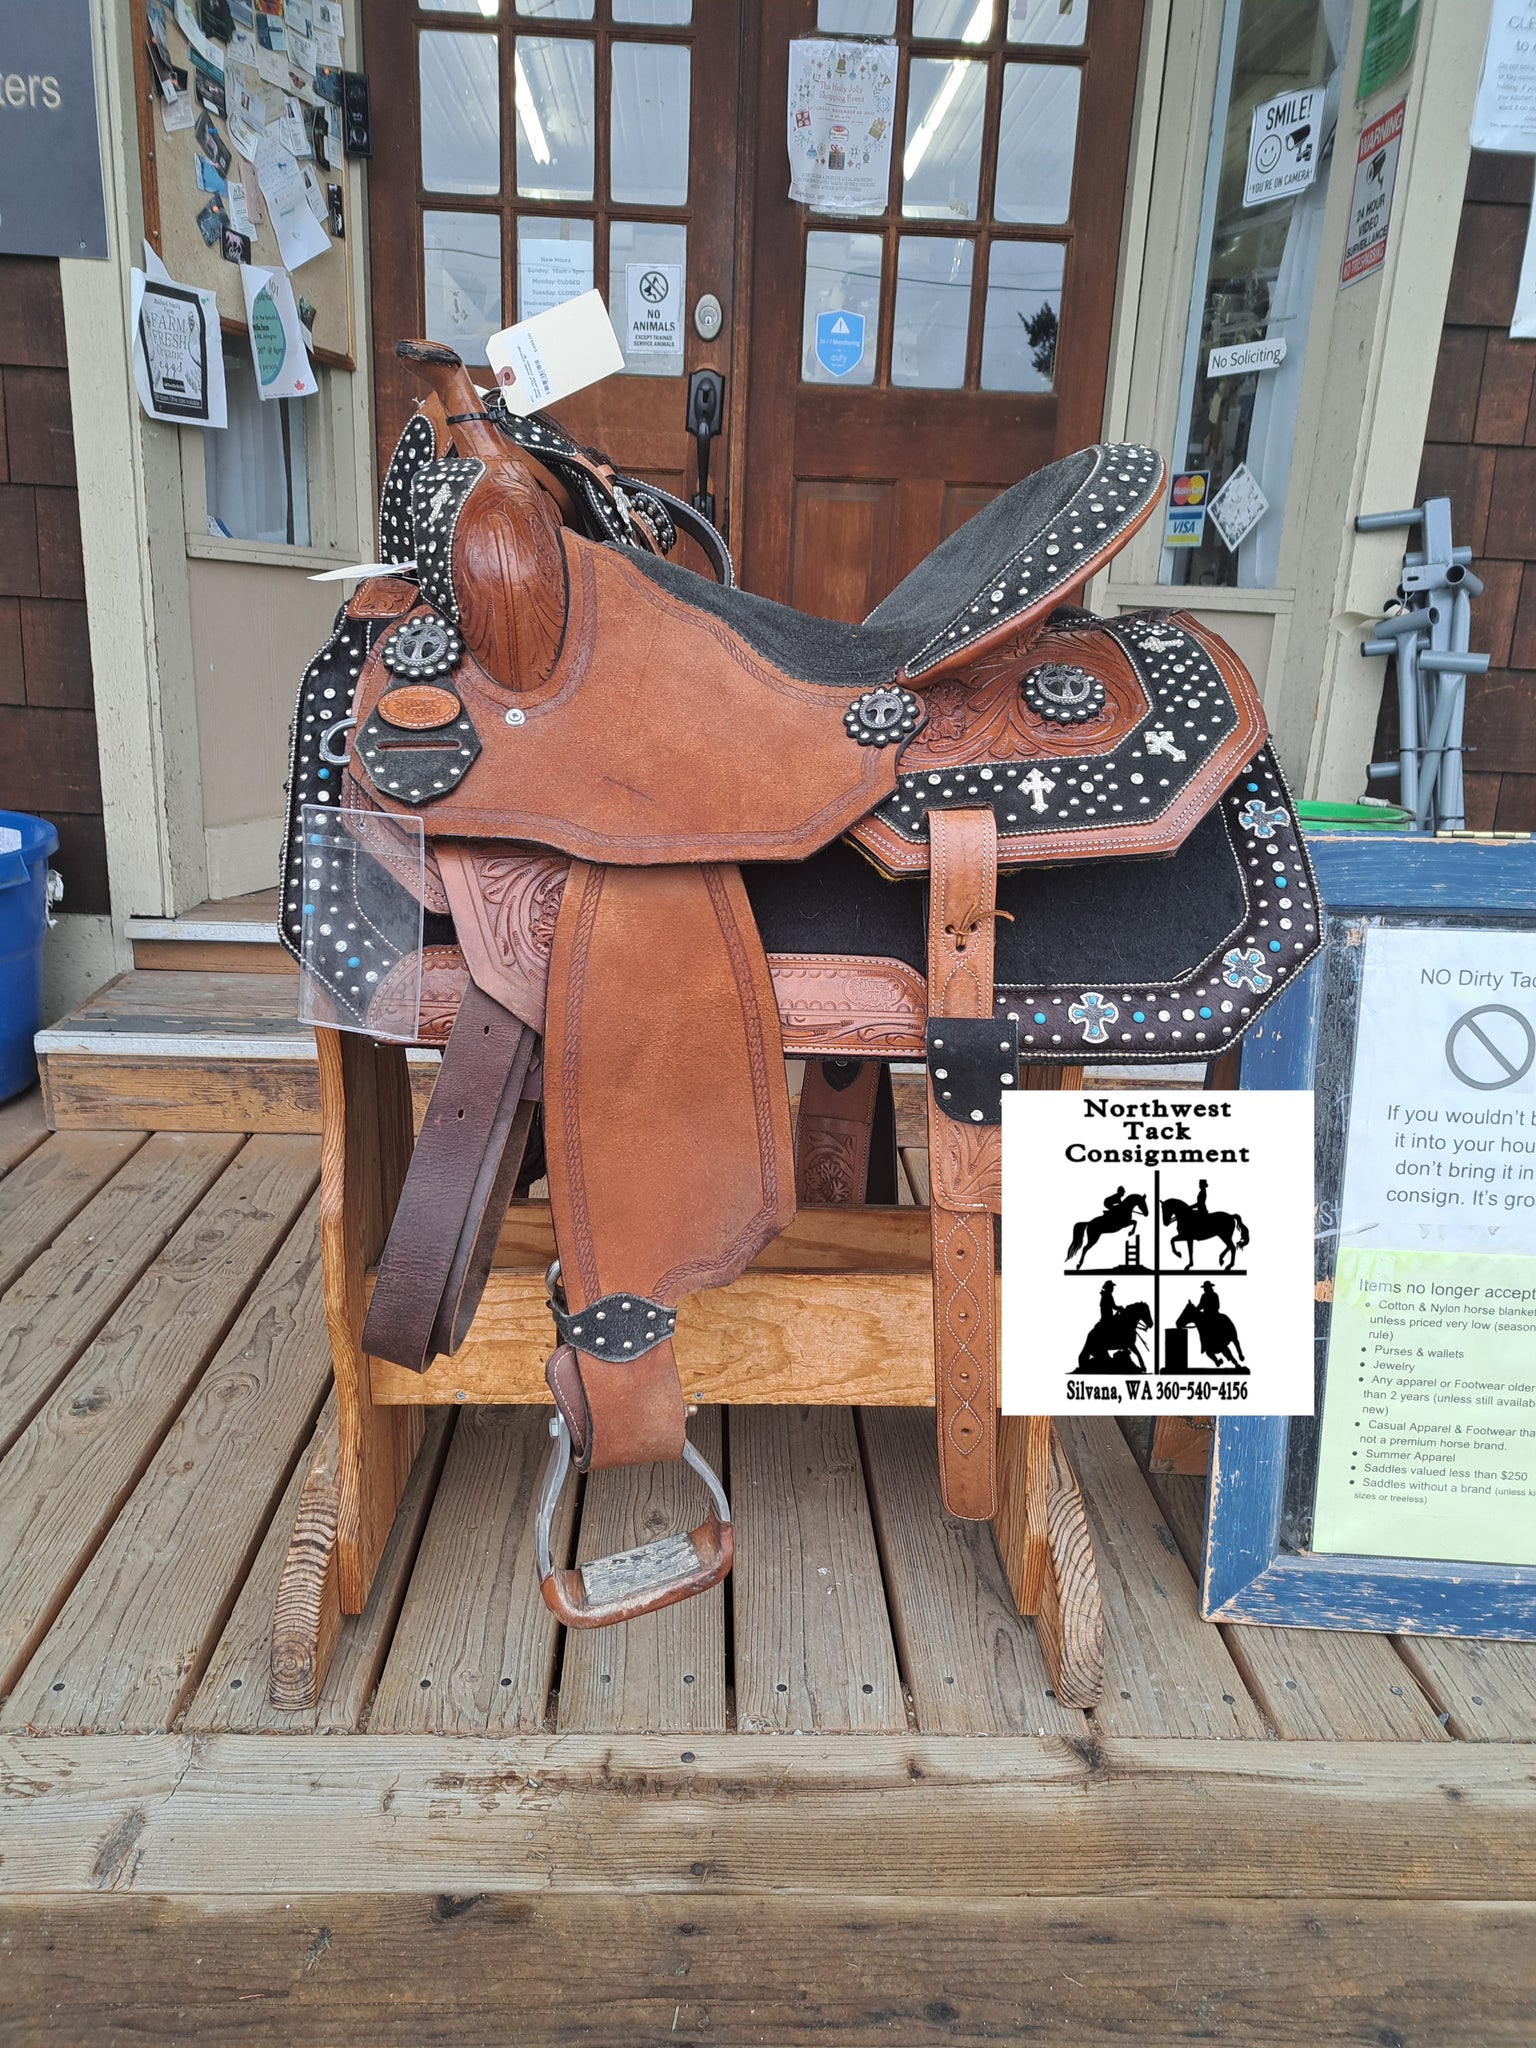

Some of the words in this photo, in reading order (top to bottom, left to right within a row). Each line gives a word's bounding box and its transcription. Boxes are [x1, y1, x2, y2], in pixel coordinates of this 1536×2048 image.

[1265, 93, 1314, 131] SMILE!
[1360, 110, 1404, 156] WARNING
[1251, 181, 1272, 194] YOU'RE
[1274, 179, 1282, 189] ON
[1284, 171, 1310, 186] CAMERA
[1356, 206, 1365, 223] 24
[1366, 193, 1386, 217] HOUR
[1359, 214, 1379, 237] VIDEO
[1347, 224, 1388, 259] SURVEILLANCE
[151, 312, 186, 333] FARM
[648, 309, 661, 319] NO
[633, 321, 676, 331] ANIMALS
[152, 330, 187, 350] FRESH
[157, 345, 184, 360] Organic
[1211, 355, 1227, 369] No
[1230, 348, 1281, 367] Soliciting
[160, 361, 183, 379] eggs
[1173, 521, 1195, 534] VISA
[1421, 968, 1451, 985] NO
[1458, 969, 1504, 991] Dirty
[1387, 1104, 1400, 1120] If
[1404, 1108, 1438, 1125] you
[1445, 1109, 1525, 1126] wouldn't
[1394, 1132, 1406, 1148] it
[1411, 1133, 1446, 1150] into
[1452, 1139, 1495, 1154] your
[1500, 1137, 1536, 1153] hou
[1395, 1159, 1442, 1177] don't
[1448, 1162, 1495, 1182] bring
[1502, 1164, 1513, 1179] it
[1518, 1164, 1534, 1180] in
[1386, 1188, 1464, 1207] consign.
[1472, 1190, 1498, 1206] It's
[1359, 1278, 1402, 1293] Items
[1406, 1283, 1426, 1294] no
[1431, 1283, 1480, 1299] longer
[1484, 1287, 1536, 1302] accept
[1378, 1299, 1415, 1311] Cotton
[1418, 1303, 1427, 1312] &
[1430, 1303, 1460, 1315] Nylon
[1463, 1305, 1495, 1315] horse
[1370, 1315, 1406, 1326] unless
[1409, 1318, 1442, 1328] priced
[1446, 1321, 1468, 1331] very
[1471, 1320, 1490, 1330] low
[1368, 1330, 1394, 1342] rule)
[1374, 1345, 1413, 1356] Purses
[1416, 1348, 1424, 1356] &
[1428, 1349, 1464, 1358] wallets
[1373, 1360, 1415, 1373] Jewelry
[1371, 1375, 1393, 1386] Any
[1396, 1377, 1437, 1388] apparel
[1440, 1380, 1451, 1388] or
[1454, 1379, 1505, 1390] Footwear
[1508, 1382, 1536, 1392] older
[1363, 1390, 1387, 1400] than
[1390, 1391, 1397, 1400] 2
[1400, 1393, 1430, 1402] years
[1433, 1394, 1472, 1405] (unless
[1475, 1396, 1493, 1406] still
[1496, 1397, 1536, 1408] availab
[1362, 1405, 1389, 1416] new)
[1368, 1420, 1406, 1430] Casual
[1409, 1423, 1451, 1434] Apparel
[1454, 1425, 1462, 1434] &
[1466, 1425, 1517, 1436] Footwear
[1519, 1428, 1536, 1437] tha
[1359, 1435, 1377, 1444] not
[1389, 1437, 1437, 1449] premium
[1440, 1438, 1470, 1448] horse
[1473, 1440, 1507, 1451] brand.
[1365, 1449, 1411, 1460] Summer
[1414, 1452, 1456, 1463] Apparel
[1364, 1463, 1407, 1474] Saddles
[1410, 1466, 1446, 1476] valued
[1449, 1468, 1470, 1478] less
[1474, 1470, 1497, 1479] than
[1500, 1470, 1528, 1481] $250
[1362, 1477, 1406, 1489] Saddles
[1409, 1481, 1448, 1492] without
[1461, 1483, 1492, 1494] brand
[1494, 1487, 1526, 1497] (unless
[1354, 1492, 1375, 1500] sizes
[1390, 1495, 1428, 1505] treeless)
